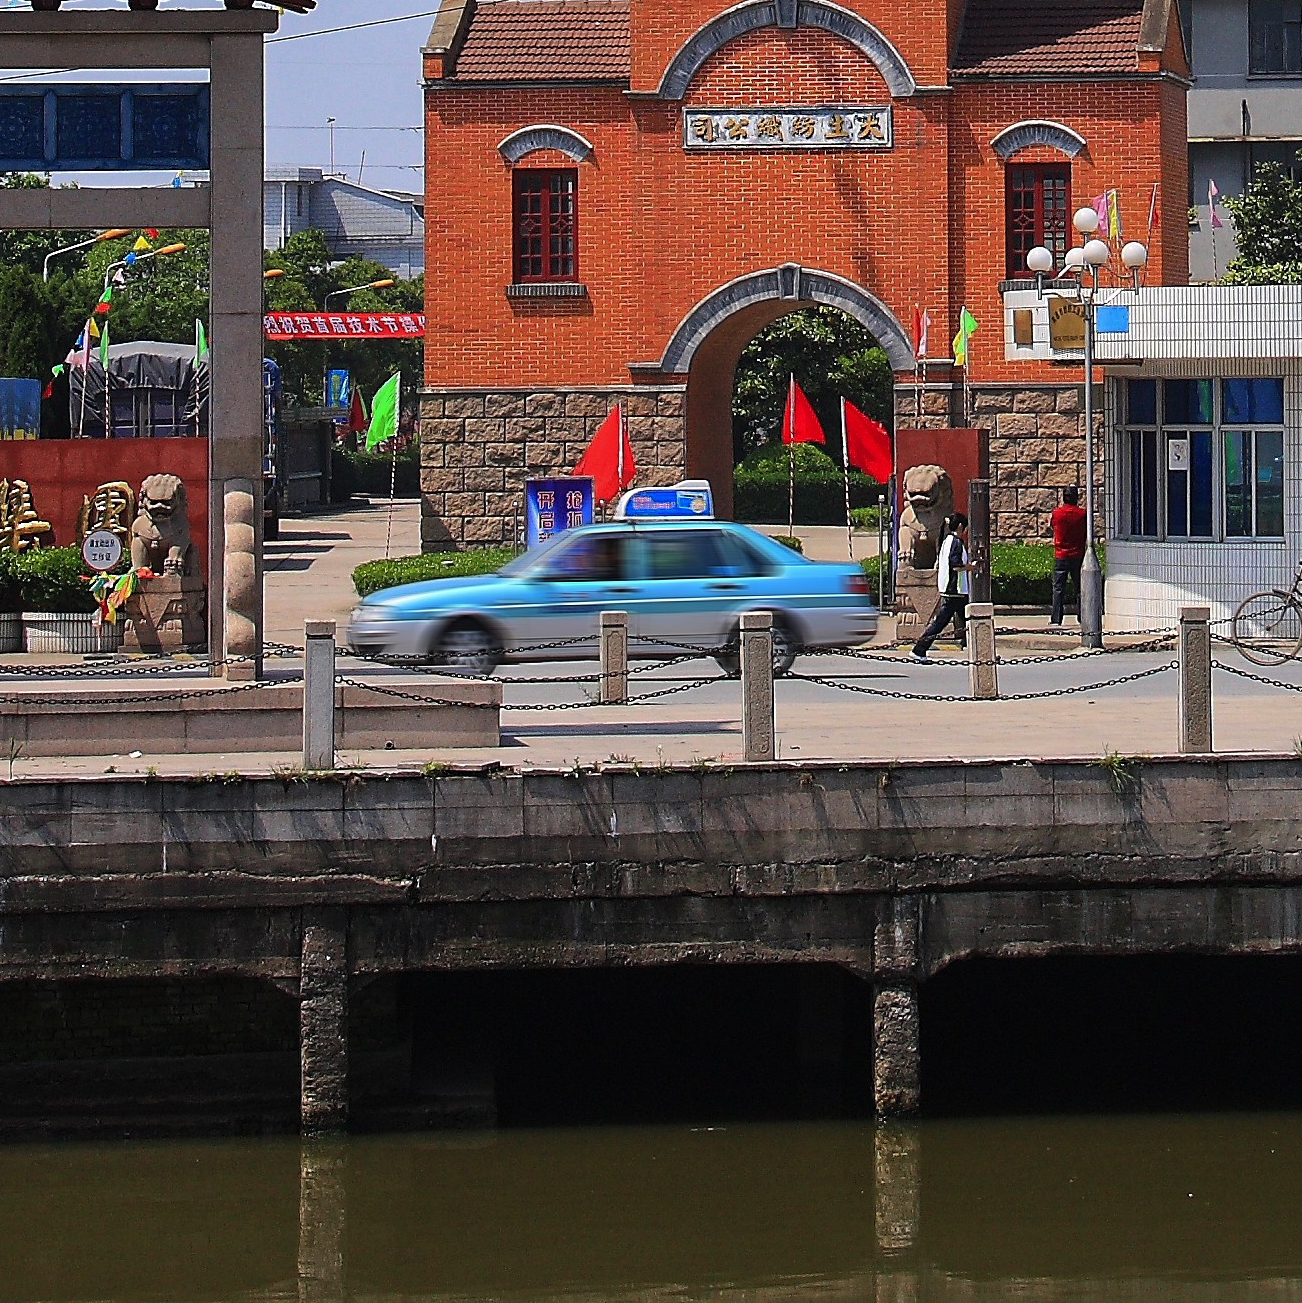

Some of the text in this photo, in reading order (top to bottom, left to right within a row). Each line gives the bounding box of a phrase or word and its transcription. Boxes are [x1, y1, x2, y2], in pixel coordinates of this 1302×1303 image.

[692, 113, 885, 142] 大生紡織公司
